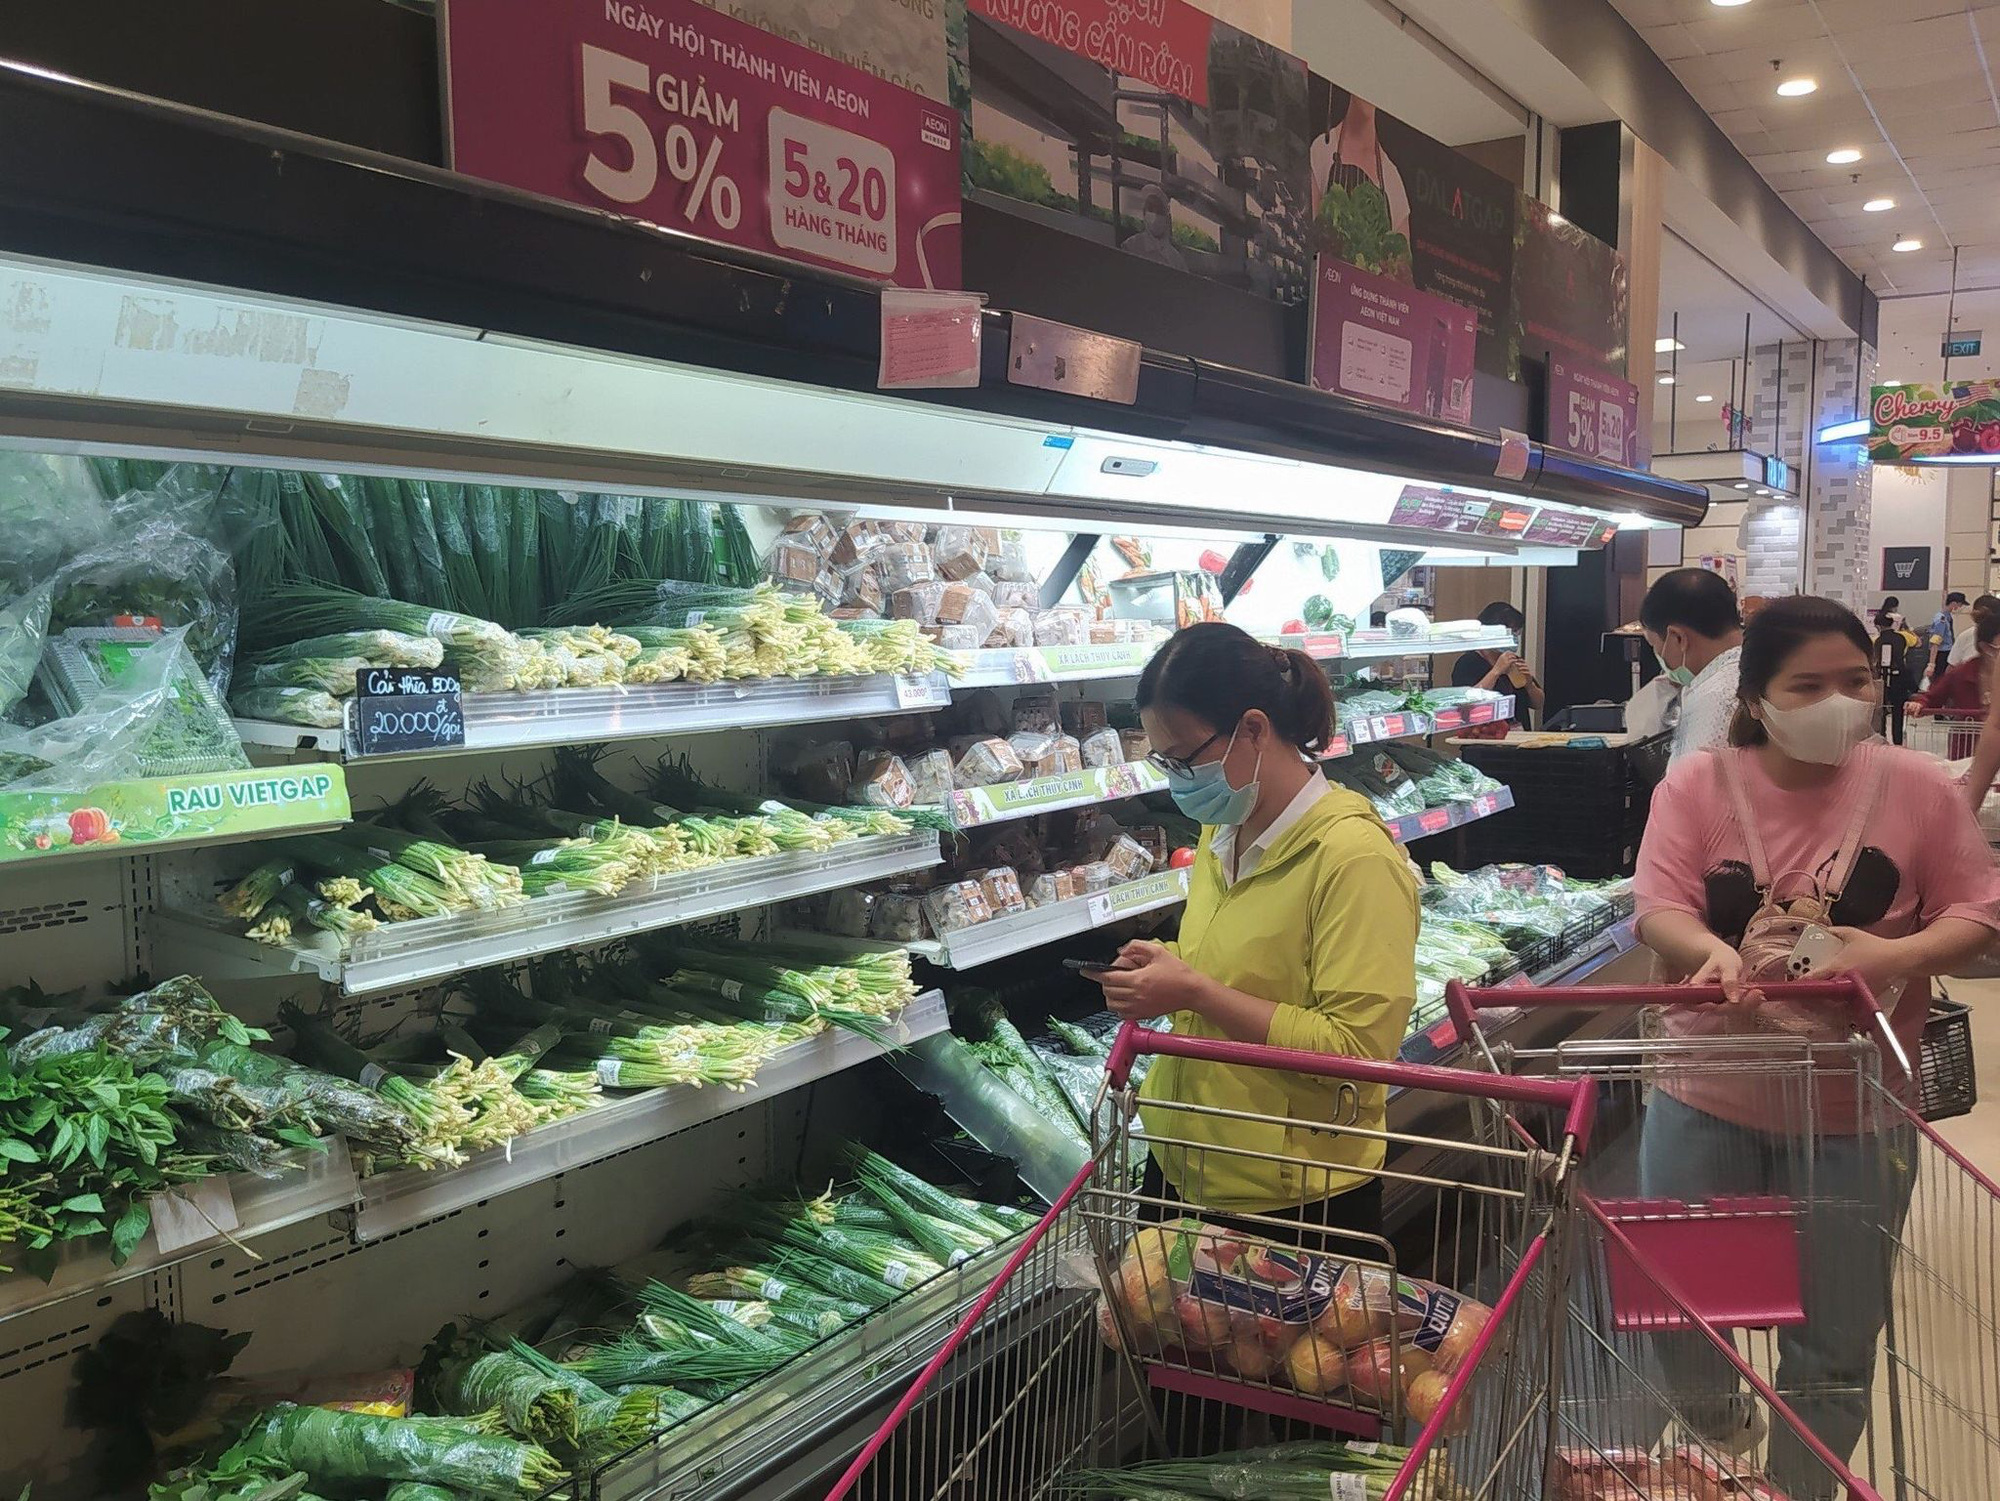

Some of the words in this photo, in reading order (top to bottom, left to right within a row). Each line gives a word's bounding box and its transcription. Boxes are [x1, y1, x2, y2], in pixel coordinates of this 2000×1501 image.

[604, 1, 663, 40] NGÀY
[669, 24, 705, 58] HỘI
[710, 39, 776, 84] THÀNH
[782, 67, 821, 101] VIÊN
[825, 87, 870, 119] AEON
[656, 74, 738, 133] GIẢM
[582, 42, 741, 230] 5%
[924, 116, 948, 135] AEON
[785, 205, 831, 236] HÀNG
[836, 223, 887, 252] THÁNG
[1952, 343, 1977, 354] EXIT
[1874, 391, 1958, 425] Cherry
[1919, 429, 1942, 441] 9.5
[431, 677, 461, 702] 500g
[168, 786, 223, 813] RAU
[229, 774, 332, 807] VIETGAP
[1017, 784, 1040, 800] LCH
[1062, 779, 1084, 792] CANH
